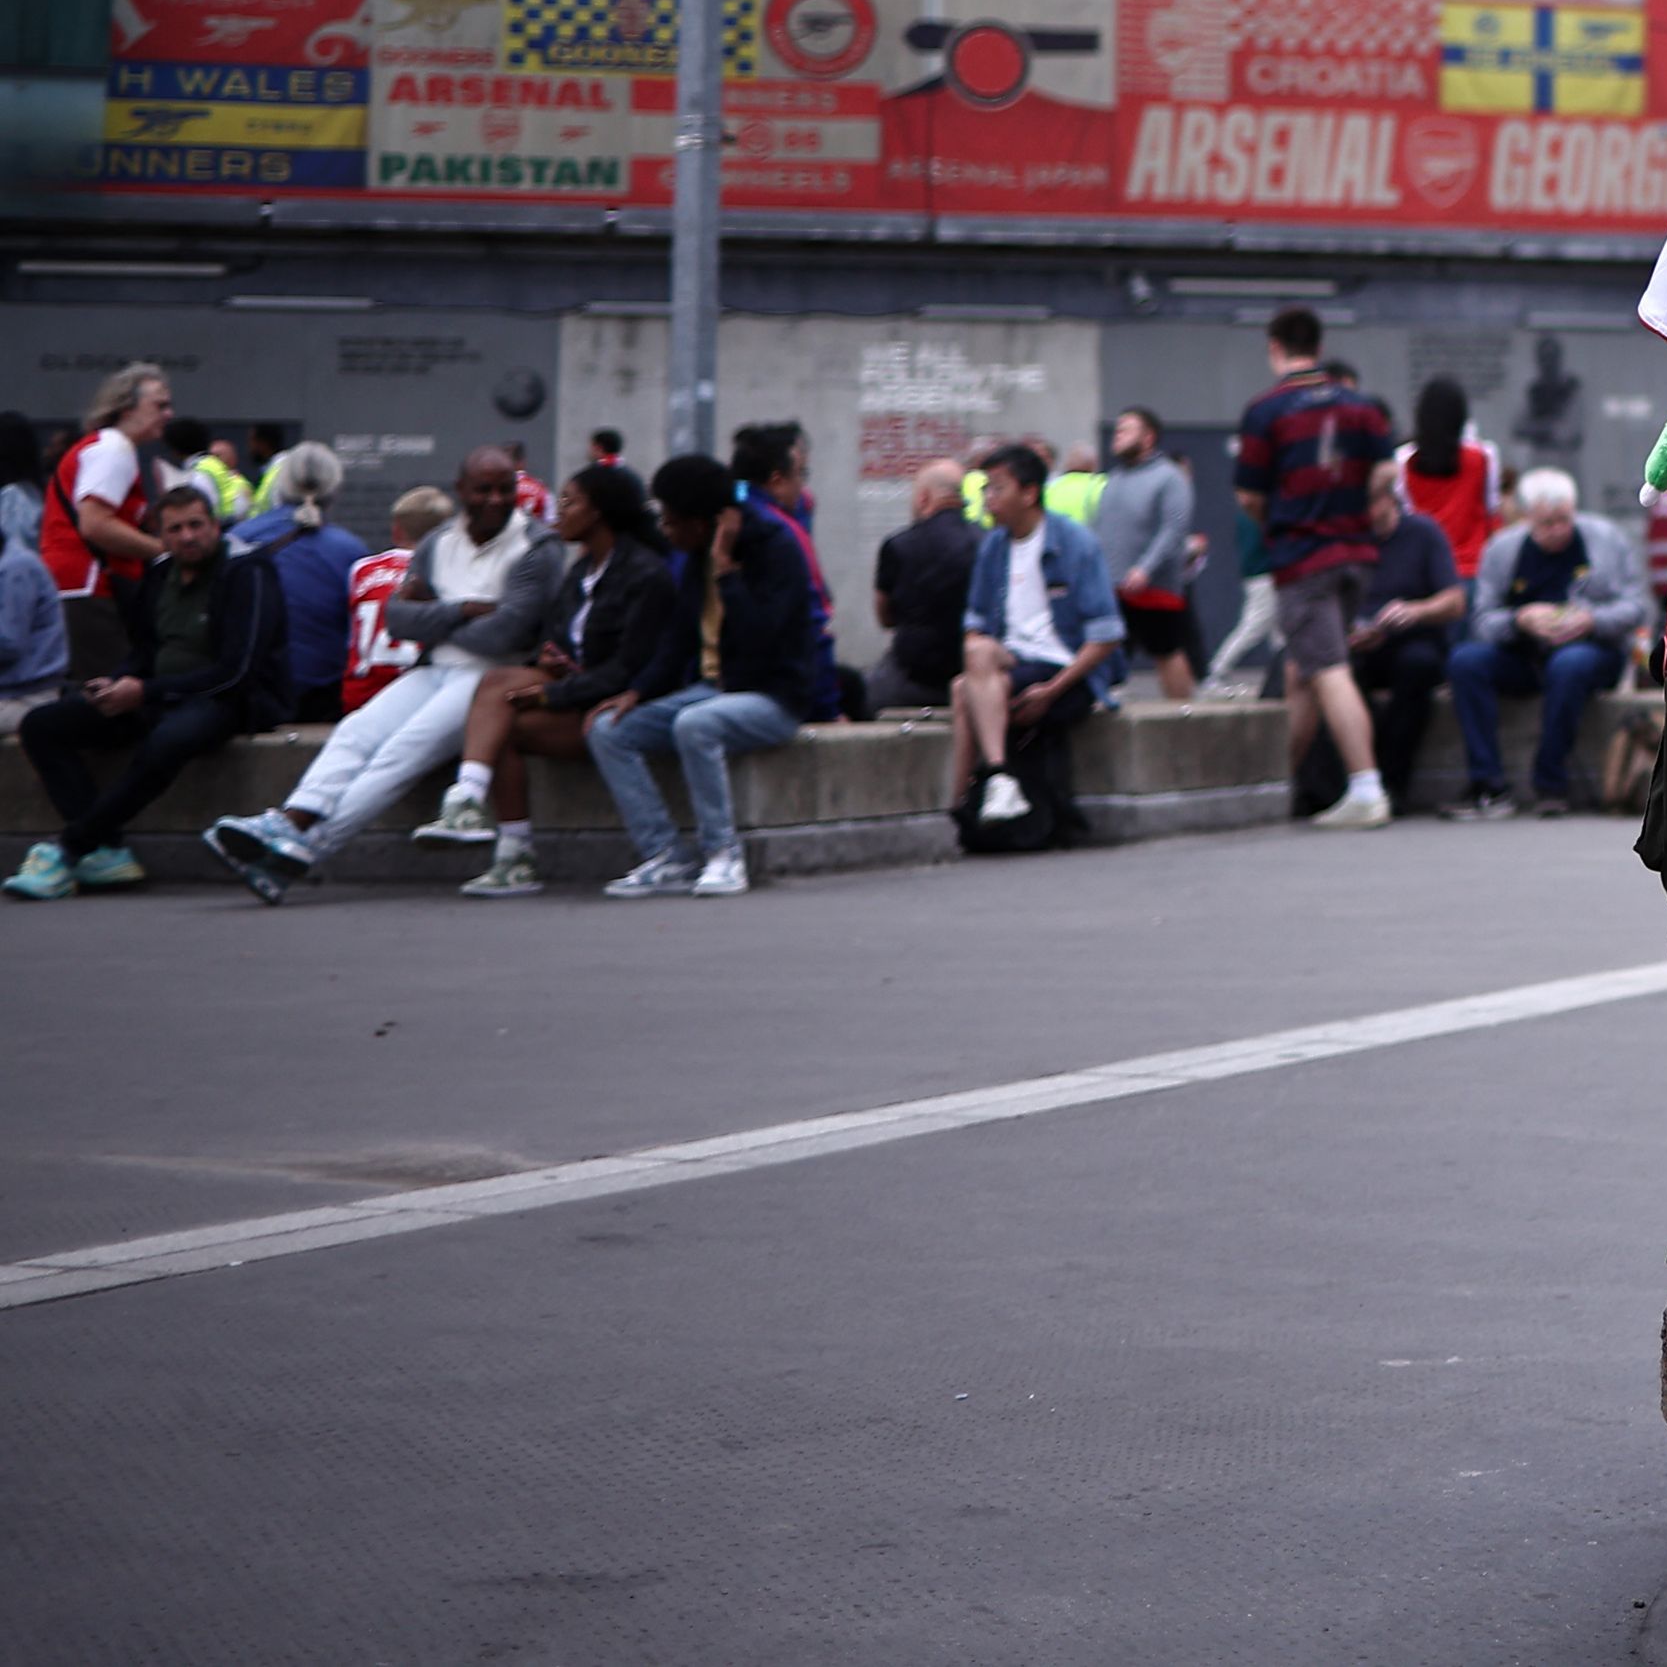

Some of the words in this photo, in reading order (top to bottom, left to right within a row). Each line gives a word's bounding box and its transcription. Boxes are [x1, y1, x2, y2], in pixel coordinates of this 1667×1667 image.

[176, 68, 356, 102] WALES
[386, 73, 615, 113] ARSENAL
[1245, 57, 1426, 98] CROATIA
[76, 147, 293, 183] UNNERS
[379, 154, 620, 190] PAKISTAN
[1124, 102, 1404, 210] ARSENAL
